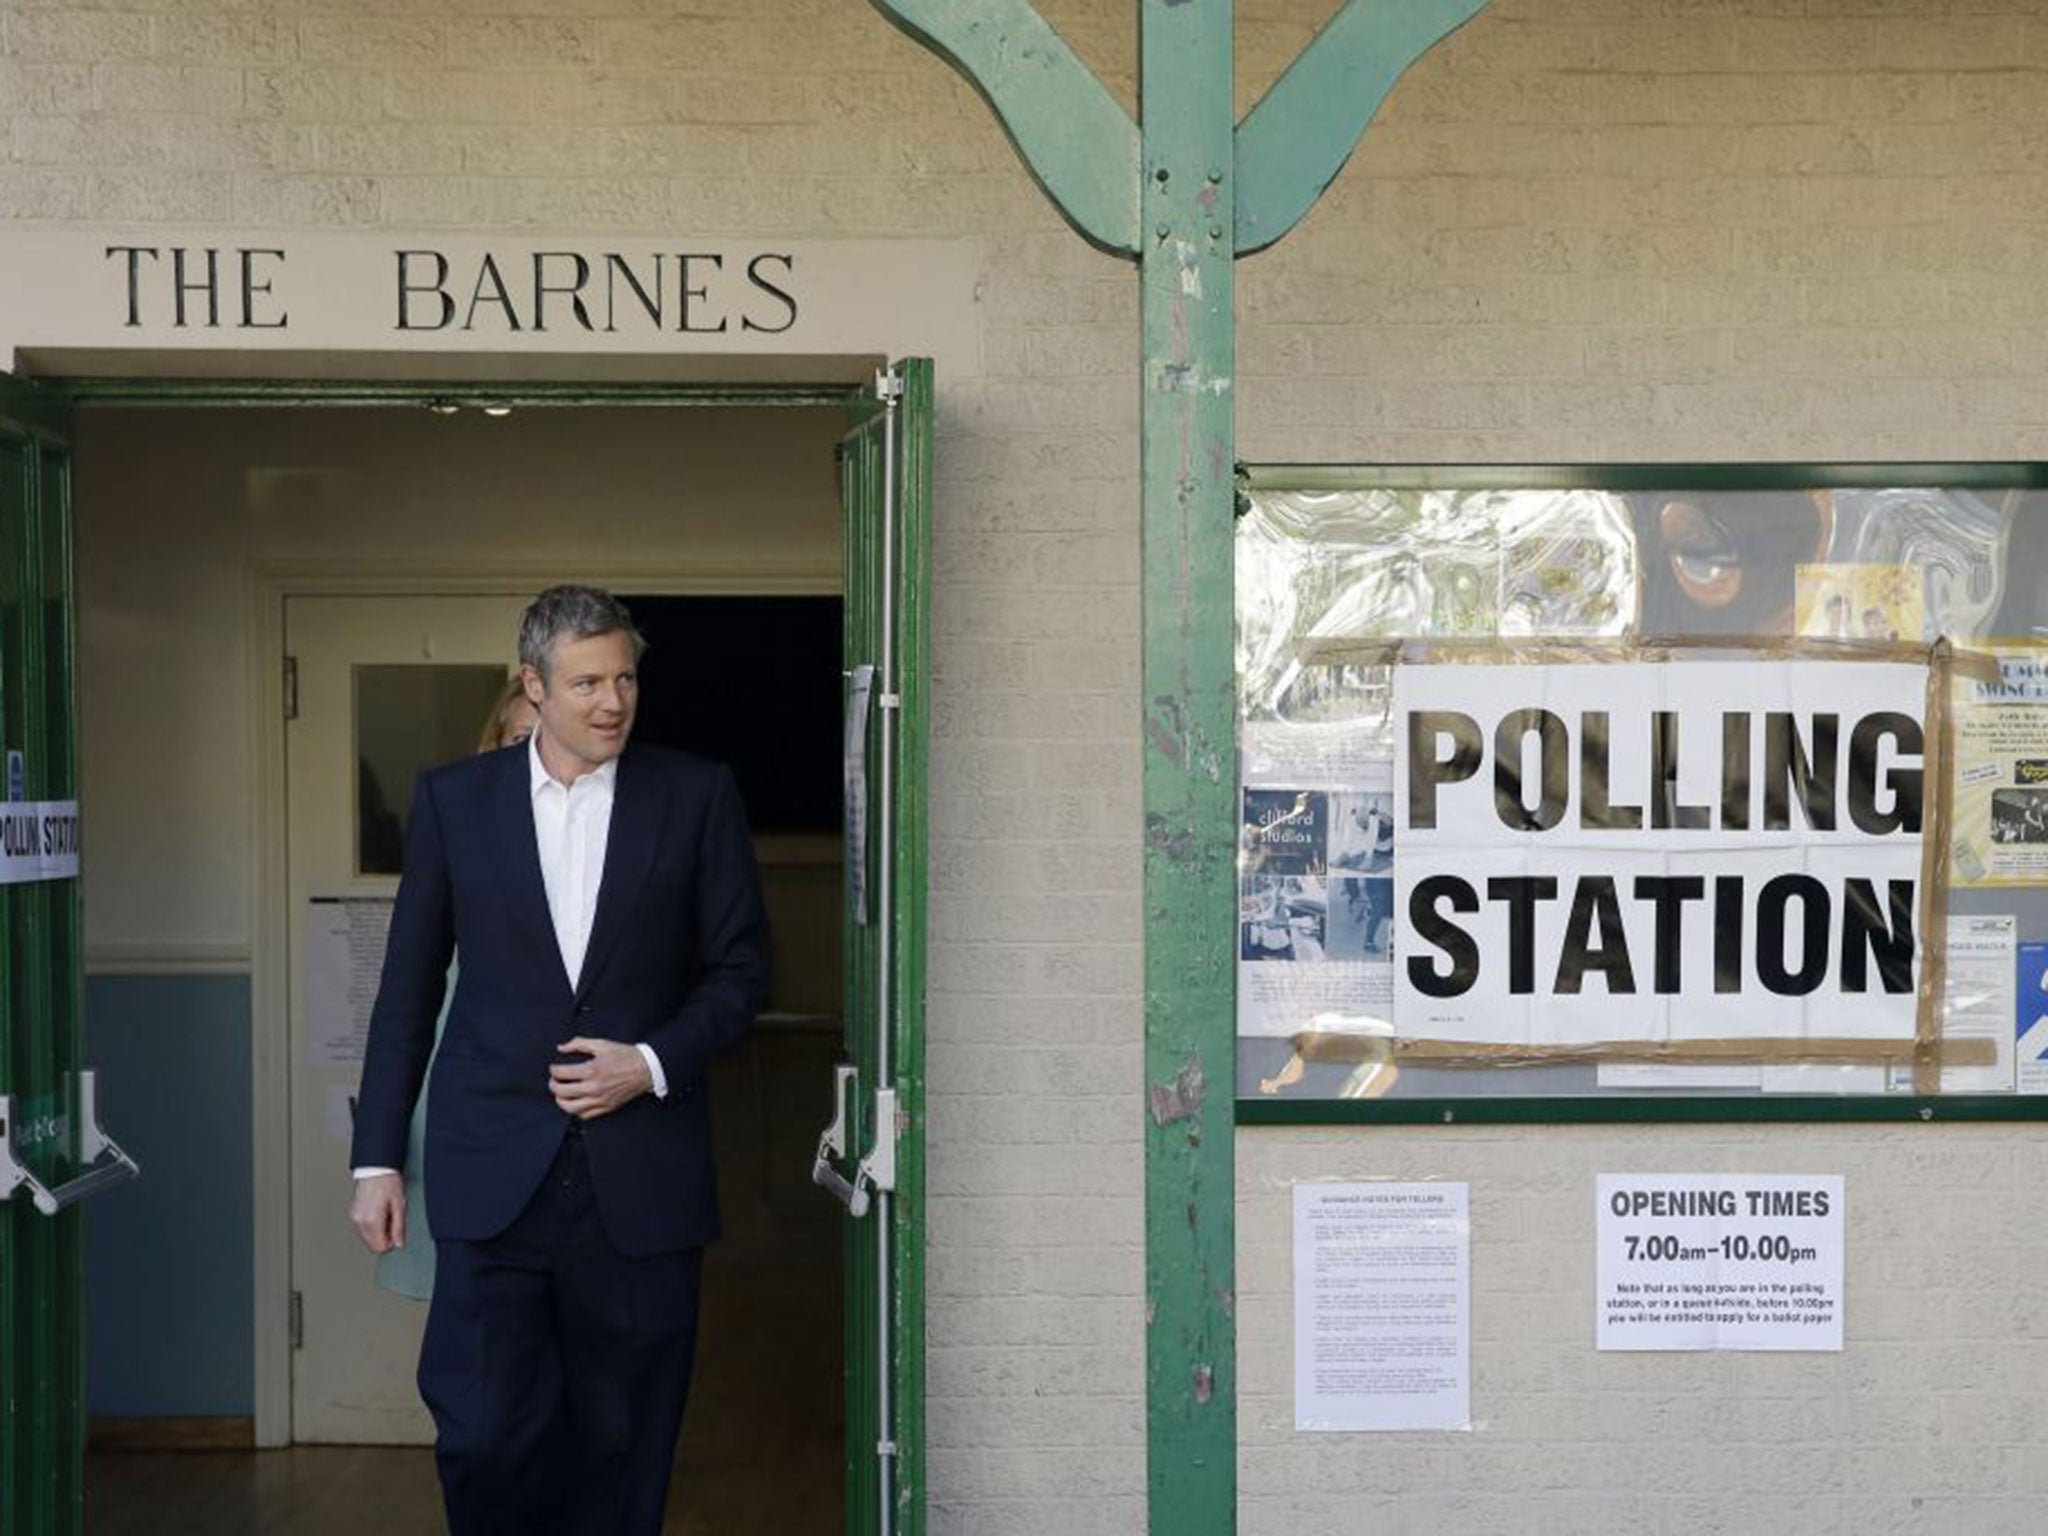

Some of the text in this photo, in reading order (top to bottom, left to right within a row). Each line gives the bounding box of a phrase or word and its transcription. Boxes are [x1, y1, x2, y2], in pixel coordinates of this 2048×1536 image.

[106, 247, 797, 333] THE BARNES
[1407, 708, 1924, 835] POLLING
[1406, 874, 1917, 998] STATION
[1611, 1190, 1830, 1217] OPENING TIMES
[1643, 1284, 1664, 1294] that
[1666, 1285, 1679, 1294] as
[1682, 1284, 1703, 1296] long
[1717, 1285, 1737, 1296] you
[1739, 1285, 1756, 1294] are
[1758, 1283, 1769, 1293] in
[1771, 1284, 1787, 1294] the
[1790, 1283, 1824, 1296] polling
[1647, 1300, 1658, 1309] or
[1756, 1298, 1789, 1308] before
[1607, 1314, 1626, 1325] you
[1746, 1312, 1760, 1322] for
[1763, 1314, 1770, 1322] a
[1772, 1313, 1801, 1322] ballot
[1803, 1313, 1833, 1325] paper
